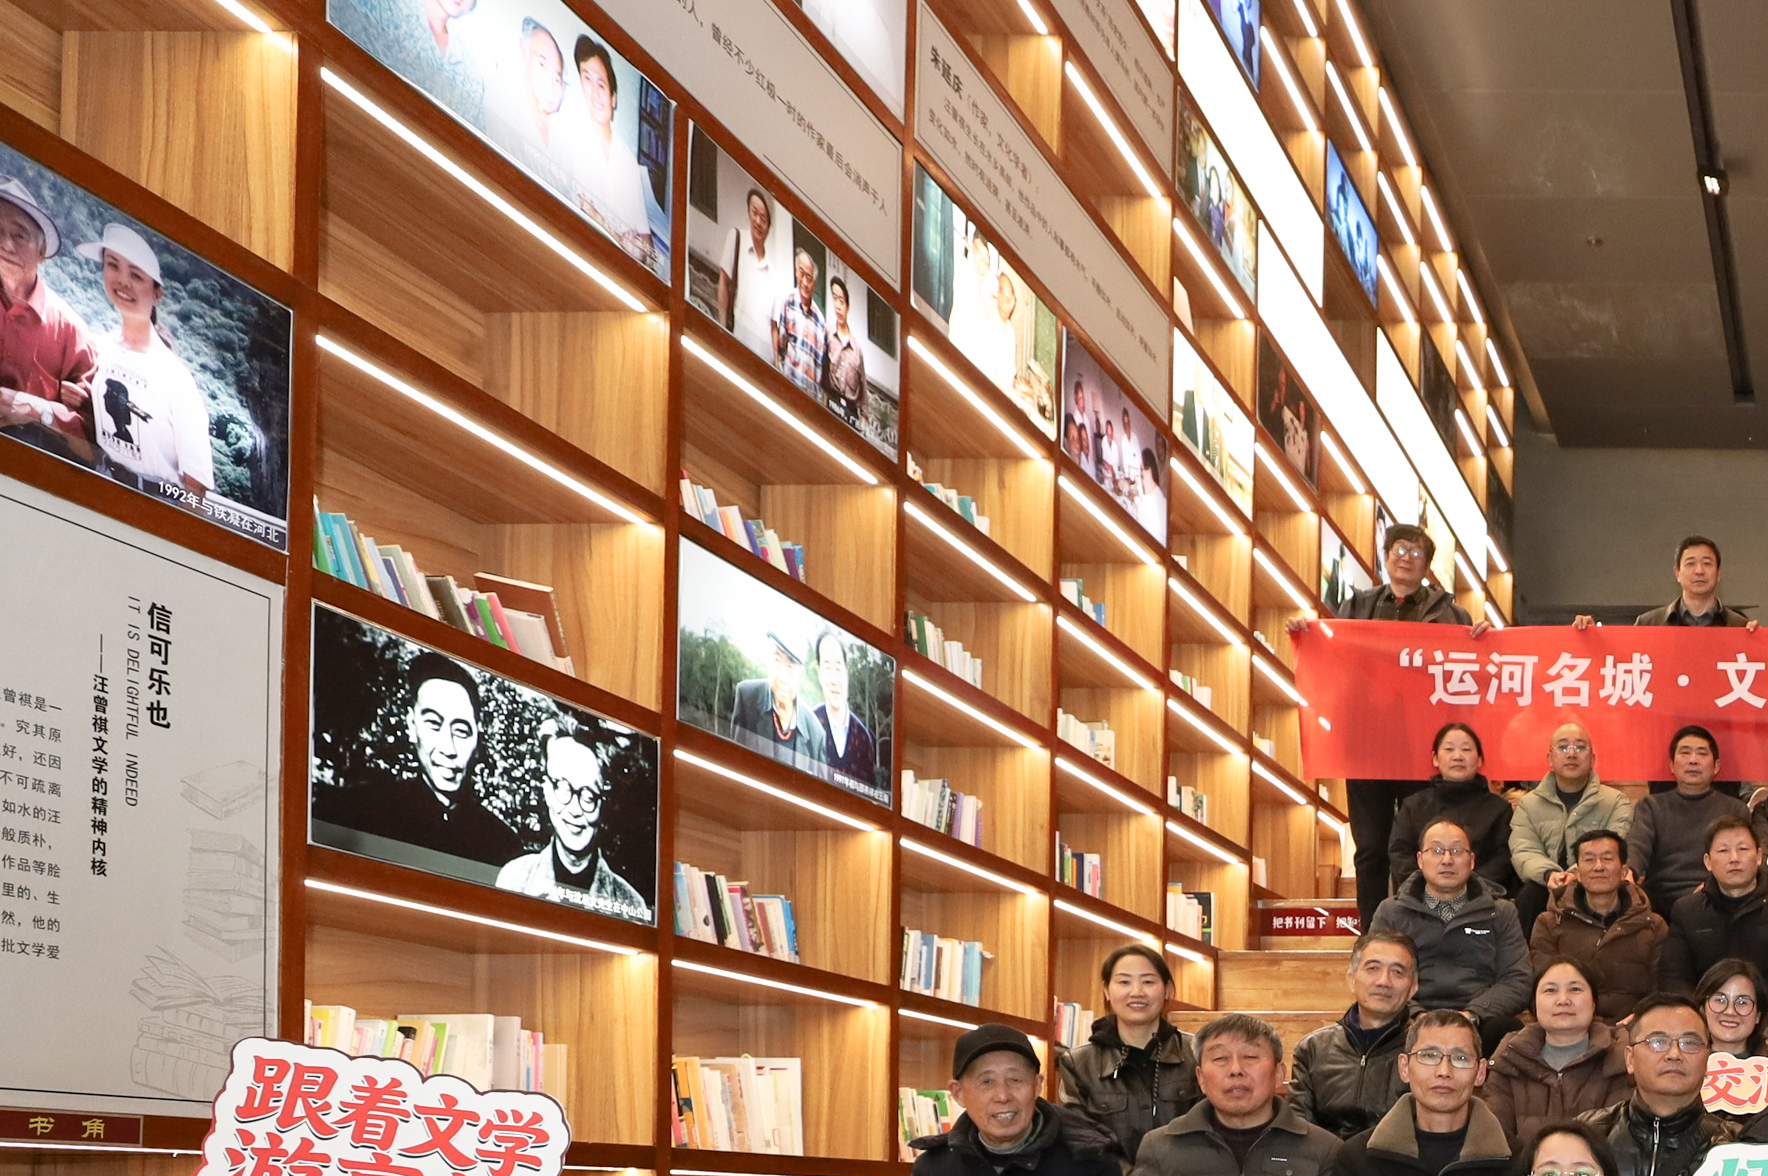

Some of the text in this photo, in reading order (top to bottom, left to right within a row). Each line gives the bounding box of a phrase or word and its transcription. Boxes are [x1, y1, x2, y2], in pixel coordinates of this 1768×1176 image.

[158, 480, 279, 543] 1992年与铁凝在河北
[146, 601, 173, 730] 信可乐也
[0, 687, 62, 713] 曾祺是一
[125, 596, 140, 807] IT IS DELIGHTFUL INDEED
[0, 743, 62, 770] 好，还因
[0, 769, 62, 797] 不可疏离
[2, 799, 62, 825] 如水的汪
[1, 827, 54, 850] 般质朴，
[1, 854, 62, 880] 作品等脍
[2, 882, 61, 907] 里的、生
[1, 909, 61, 934] 然，他的
[1272, 916, 1327, 929] 把书刊留下
[1, 937, 61, 961] 批文学爱
